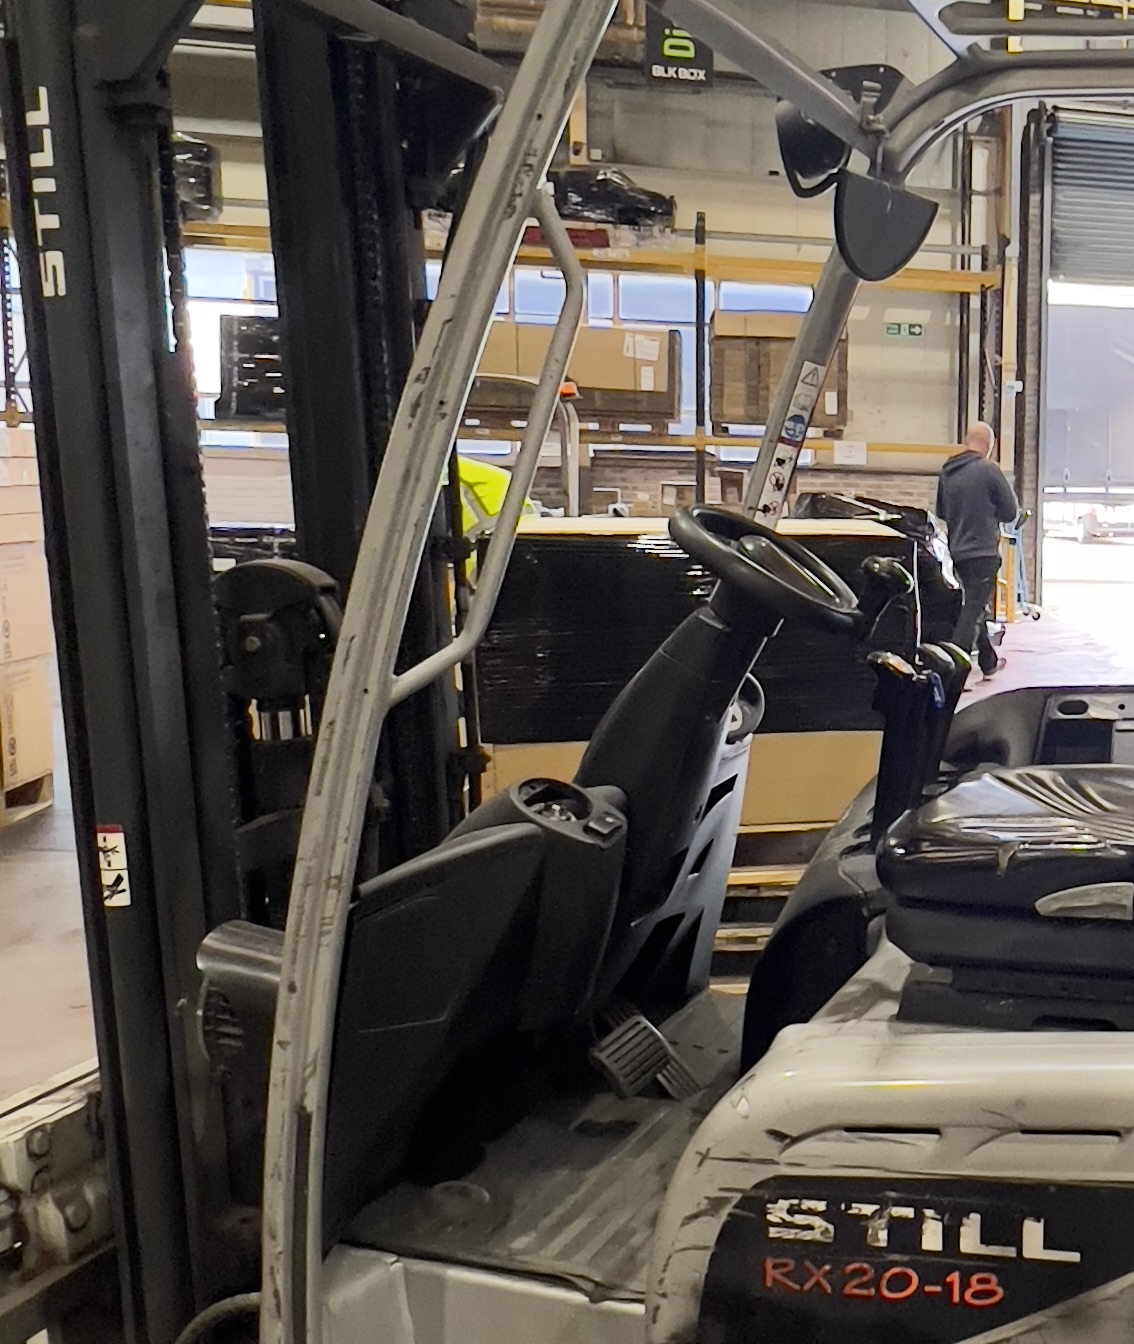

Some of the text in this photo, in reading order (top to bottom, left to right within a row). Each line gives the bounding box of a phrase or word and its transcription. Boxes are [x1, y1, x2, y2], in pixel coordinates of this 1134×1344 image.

[651, 64, 706, 81] BLK BOX
[25, 85, 67, 297] STILL
[765, 1199, 1082, 1263] STILL
[763, 1257, 1004, 1306] RX20-18
